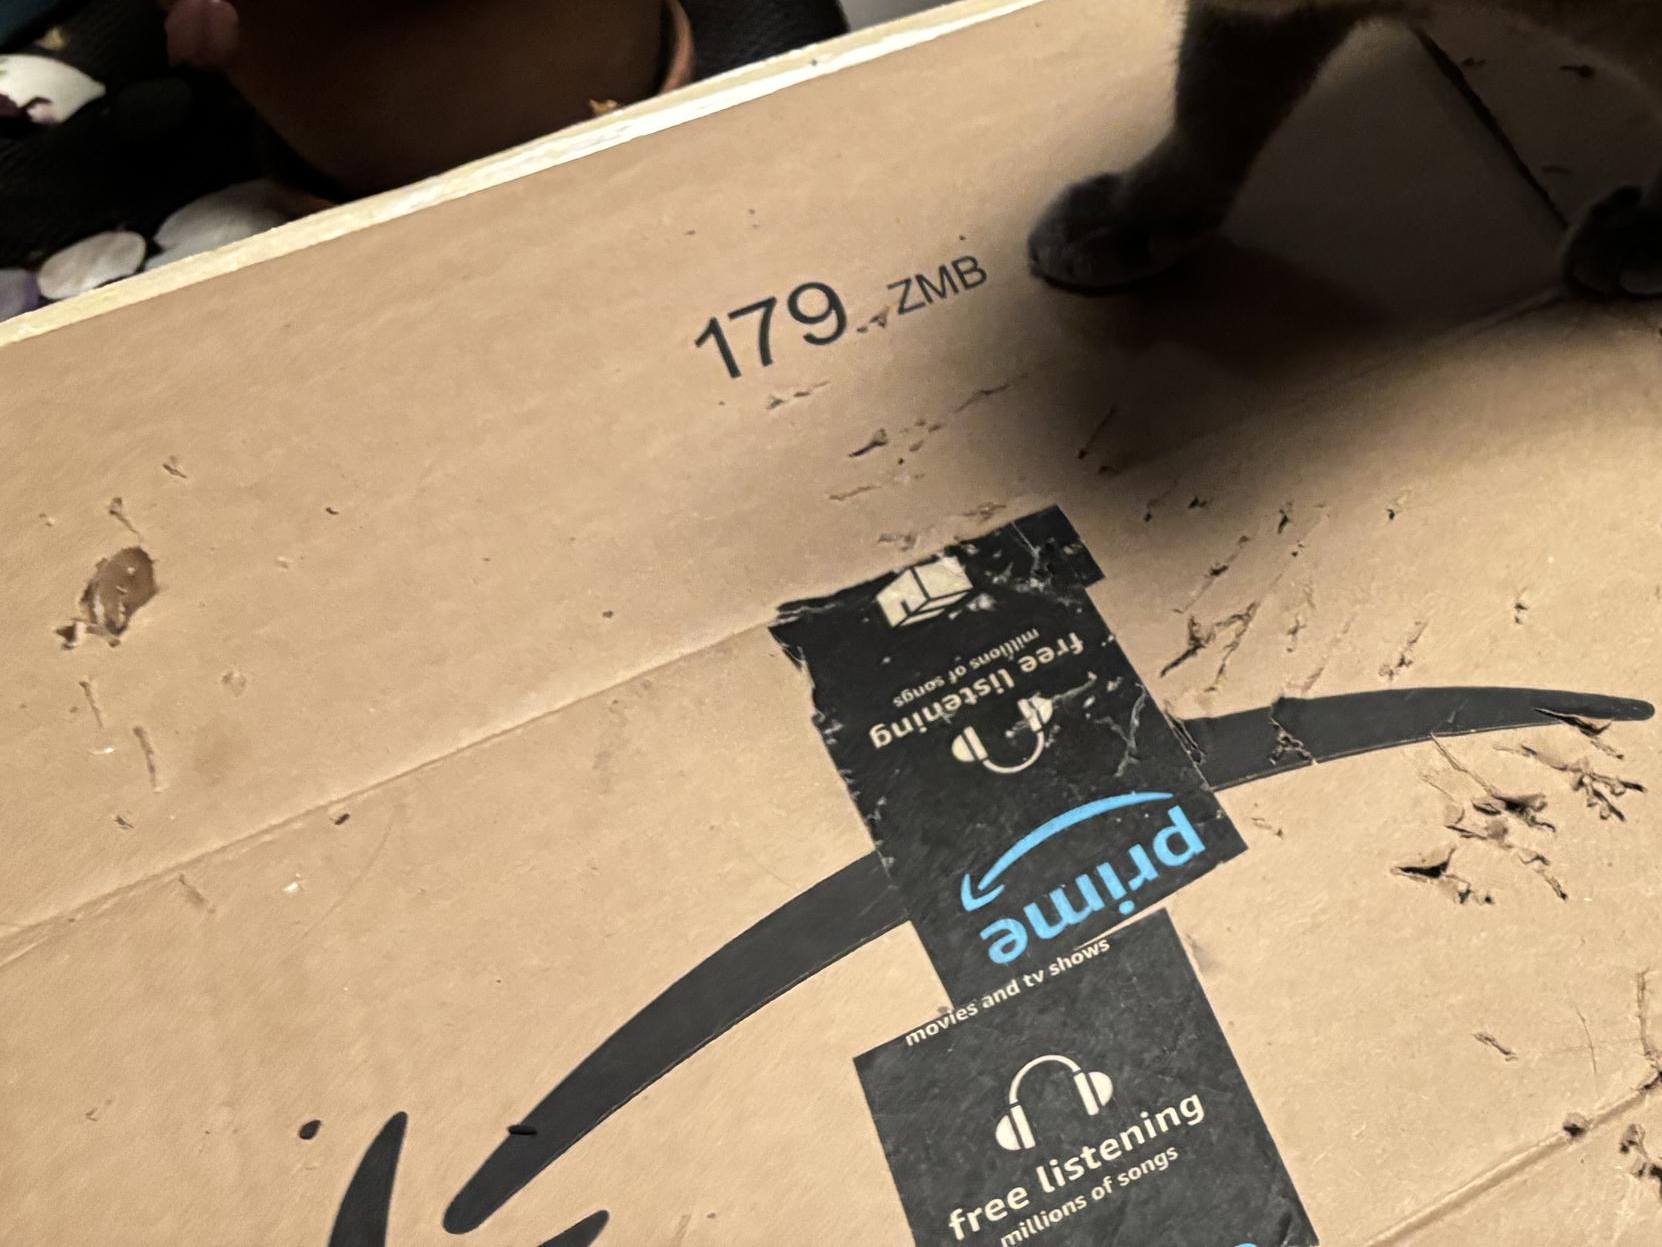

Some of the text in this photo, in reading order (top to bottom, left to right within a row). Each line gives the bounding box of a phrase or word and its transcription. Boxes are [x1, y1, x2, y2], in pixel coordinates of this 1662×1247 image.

[694, 255, 988, 379] 179 ZMB
[869, 632, 1084, 749] free listening
[893, 628, 1040, 707] millions of songs
[979, 805, 1206, 964] prime
[905, 939, 1111, 1047] movies and tv shows
[948, 1094, 1205, 1241] free listening
[1000, 1146, 1179, 1247] millions of songs
